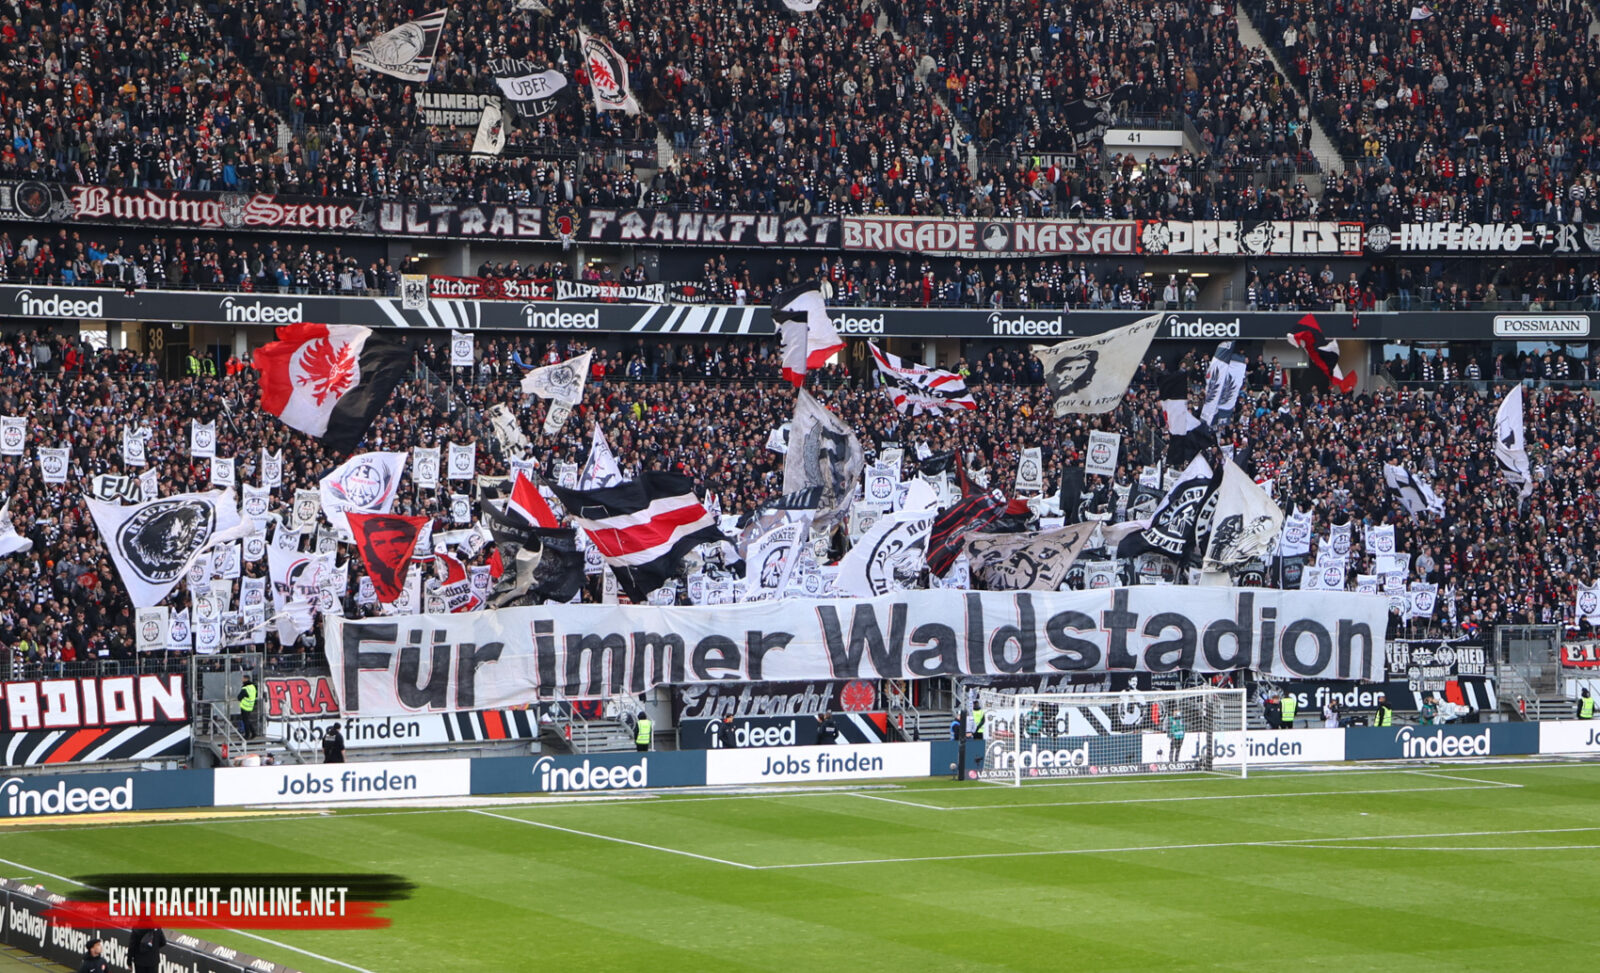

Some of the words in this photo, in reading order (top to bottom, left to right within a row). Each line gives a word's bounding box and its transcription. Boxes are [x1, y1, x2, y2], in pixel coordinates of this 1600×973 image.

[516, 98, 558, 118] ALLES
[1127, 132, 1142, 144] 41
[71, 185, 225, 228] Binding
[243, 193, 356, 229] Szene
[379, 203, 542, 237] ULTRAS
[588, 208, 838, 245] FRANKFURT
[843, 221, 977, 251] BRIGADE
[1014, 223, 1134, 254] NASSAU
[1340, 232, 1361, 251] 99
[1401, 223, 1524, 251] INFERNO
[18, 291, 104, 317] indeed
[555, 279, 665, 304] KLIPPENADLER
[222, 297, 303, 323] indeed
[523, 304, 600, 329] indeed
[830, 313, 885, 335] deed
[989, 313, 1063, 336] indeed
[1167, 316, 1241, 338] indeed
[1503, 320, 1581, 332] POSSMANN
[148, 327, 164, 350] 38
[852, 342, 865, 361] 40
[341, 621, 505, 712] Für
[530, 618, 796, 700] immer
[814, 588, 1374, 680] Waldstadion
[1457, 647, 1485, 664] RIED
[1458, 664, 1485, 674] GEBIET
[0, 673, 187, 731] ADION
[266, 678, 339, 717] FRA
[678, 681, 835, 718] Eintracht
[345, 717, 421, 741] finden
[705, 719, 796, 749] ideed
[1396, 727, 1491, 758] indeed
[761, 753, 812, 776] Jobs
[816, 752, 884, 773] finden
[989, 742, 1089, 769] indeed
[278, 773, 334, 795] Jobs
[341, 770, 417, 791] finden
[534, 757, 648, 792] indeed
[2, 778, 134, 816] indeed
[10, 901, 48, 948] betway
